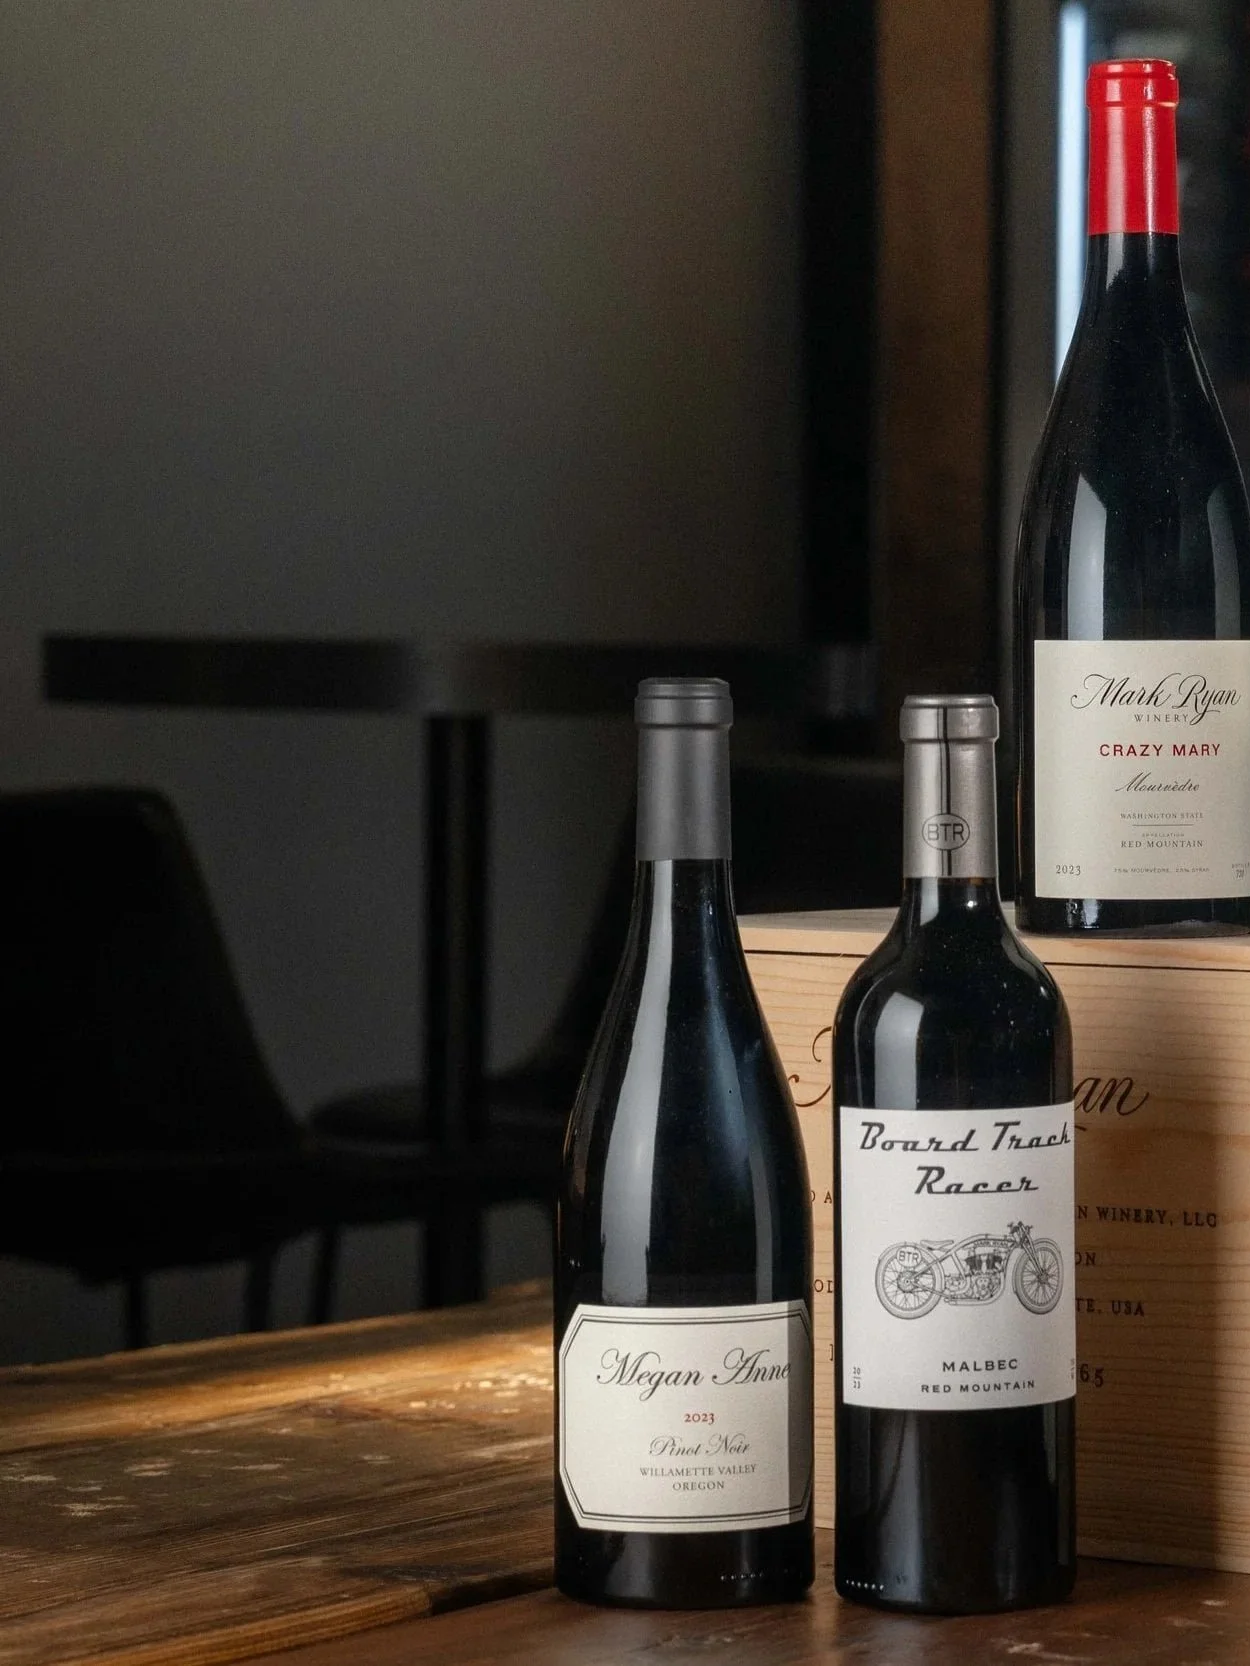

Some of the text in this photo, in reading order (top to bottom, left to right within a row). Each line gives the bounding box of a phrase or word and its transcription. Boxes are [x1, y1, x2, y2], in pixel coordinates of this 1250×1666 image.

[1070, 673, 1242, 726] Mark Ryan
[1134, 714, 1188, 723] WINERY
[1100, 744, 1220, 756] CRAZY MARY
[1115, 772, 1200, 792] Mourvèdre
[927, 823, 964, 841] BTR
[1121, 840, 1203, 848] RED MOUNTAIN
[1056, 864, 1081, 875] 2023
[860, 1121, 1071, 1152] Board Track
[914, 1166, 1038, 1194] Racer
[1095, 1205, 1174, 1227] WINERY,
[898, 1250, 919, 1262] BTR
[1111, 1299, 1145, 1317] USA
[942, 1359, 1018, 1372] MALBEC
[596, 1348, 704, 1401] Megan
[712, 1347, 791, 1385] Anne
[920, 1381, 1035, 1392] RED MOUNTAIN
[684, 1413, 715, 1424] 2023
[649, 1433, 750, 1456] Pinot Noir
[639, 1464, 757, 1477] WILLAMETTE VALLEY
[673, 1481, 725, 1491] OREGON
